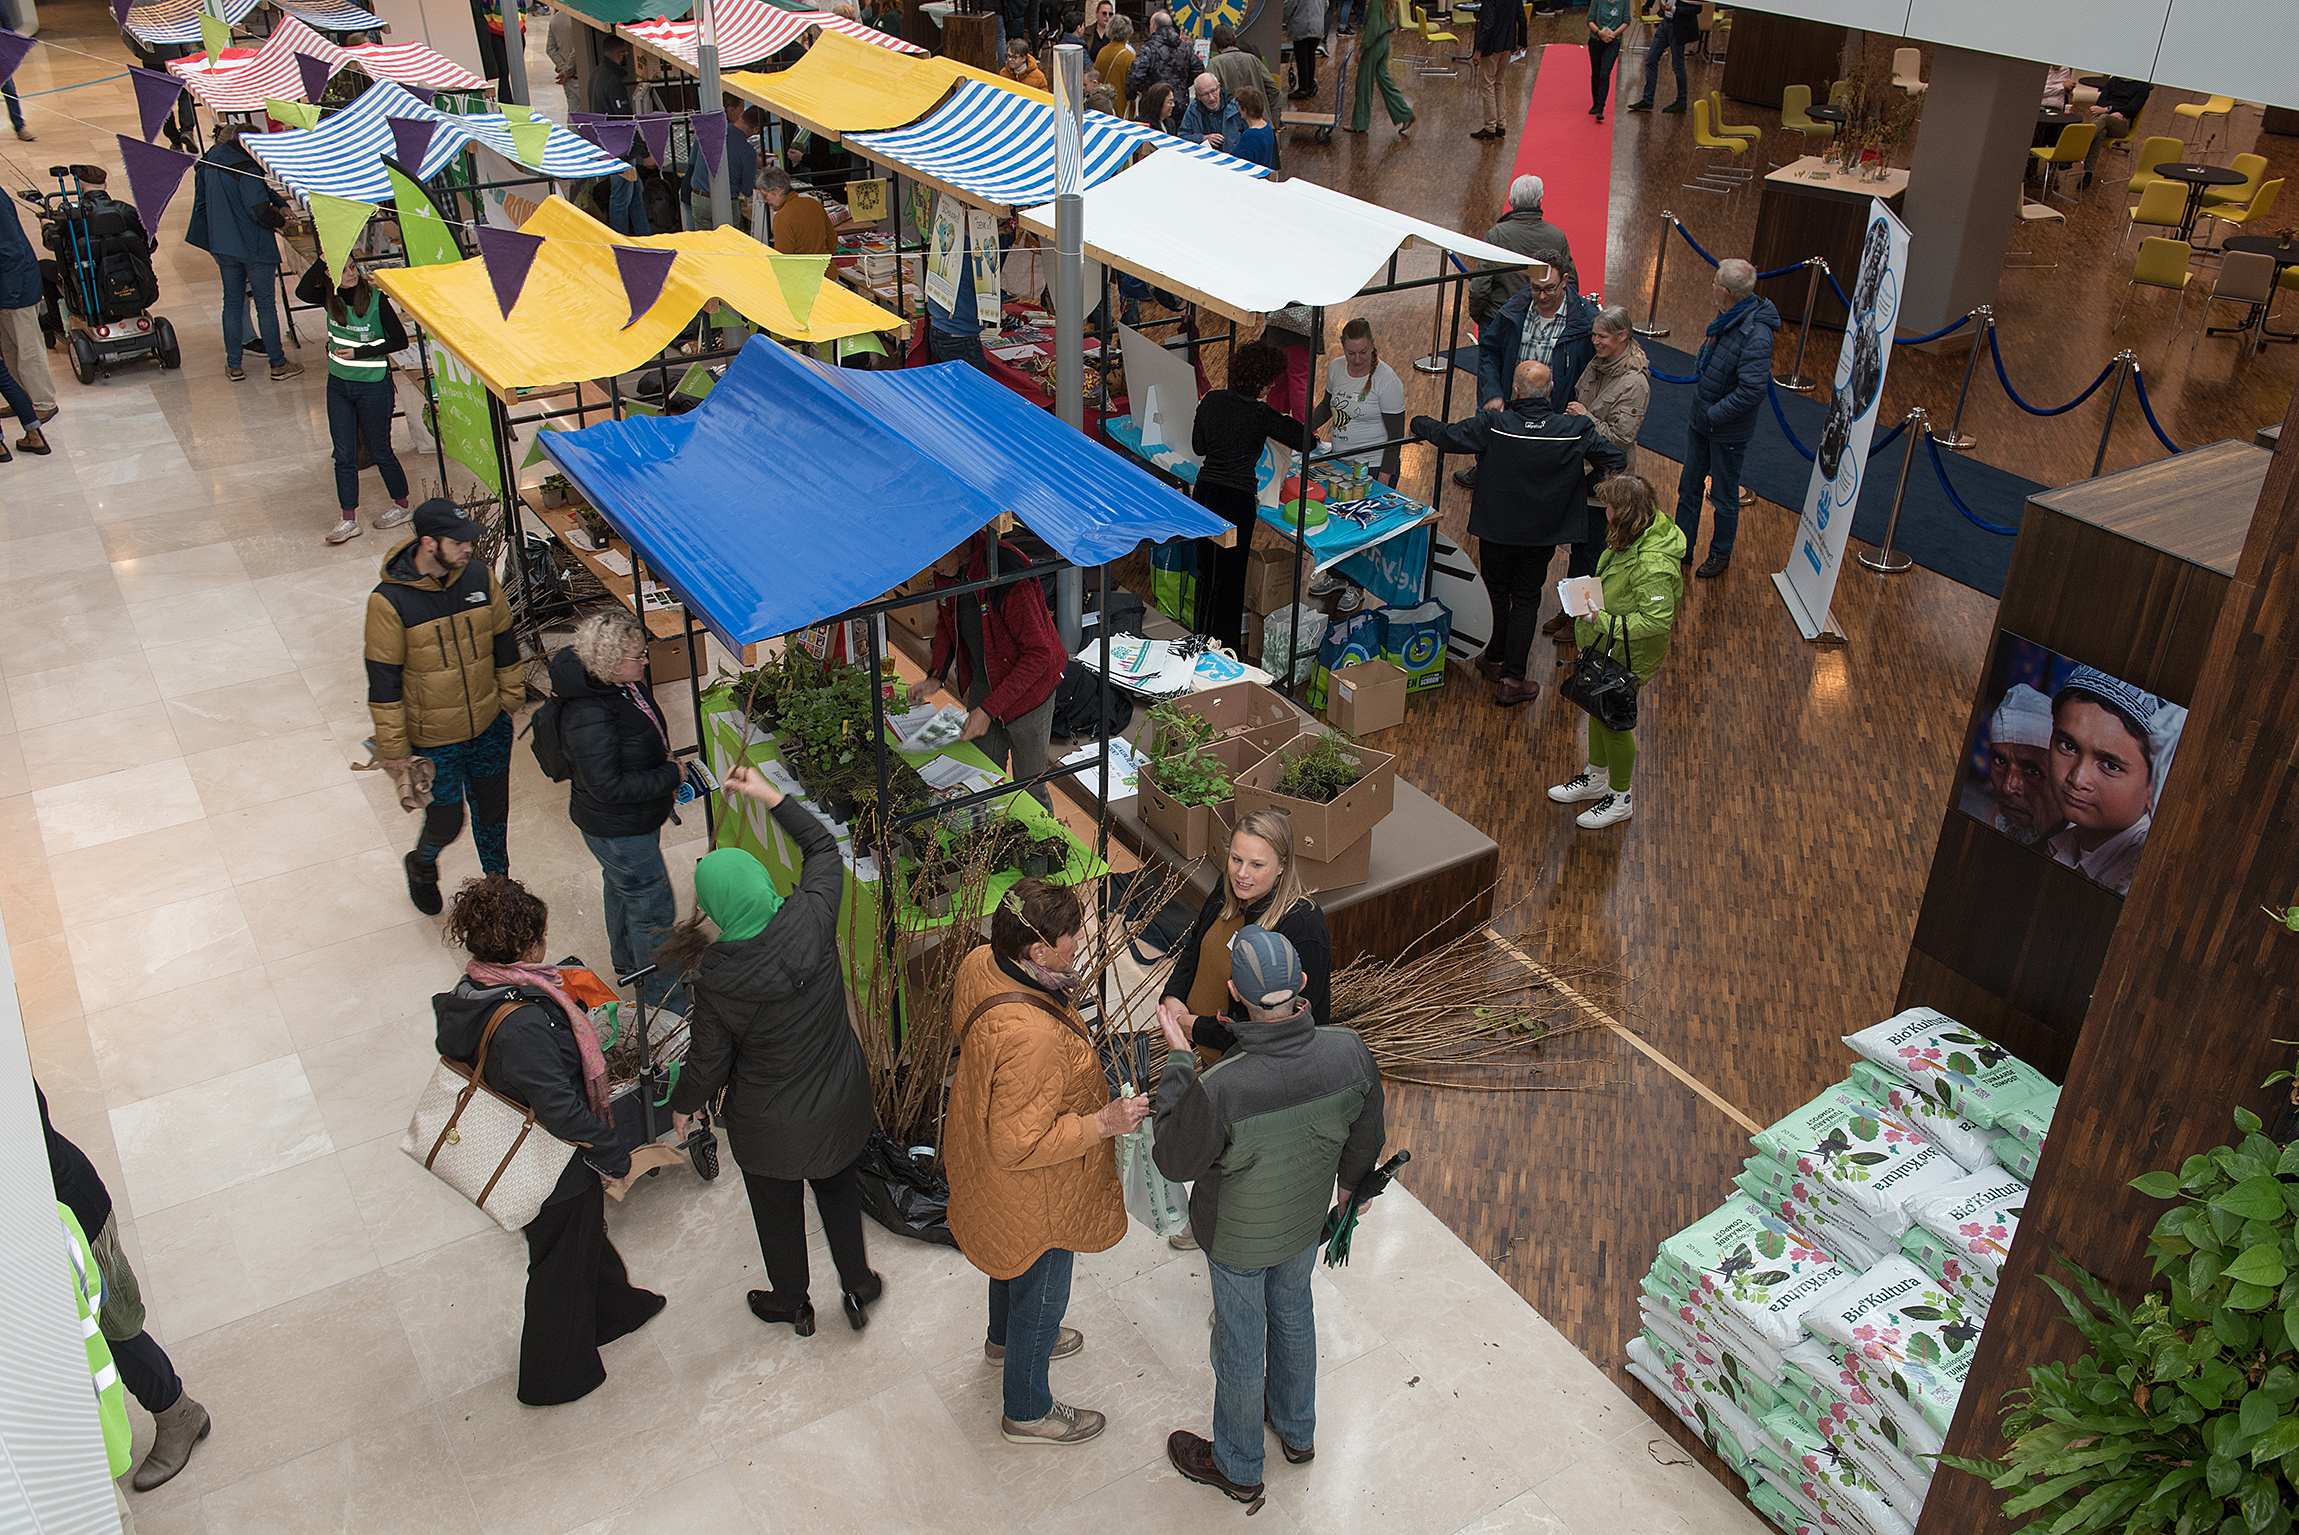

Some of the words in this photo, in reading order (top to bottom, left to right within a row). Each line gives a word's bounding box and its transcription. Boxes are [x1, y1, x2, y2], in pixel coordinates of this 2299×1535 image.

[1712, 1218, 1744, 1242] COMPOST
[1715, 1221, 1753, 1248] TUINAARDE
[1693, 1247, 1706, 1259] liter
[1968, 1287, 1991, 1305] TUINAARD
[1938, 1349, 1976, 1372] biologische
[1787, 1416, 1799, 1428] 20
[1796, 1422, 1810, 1435] liter
